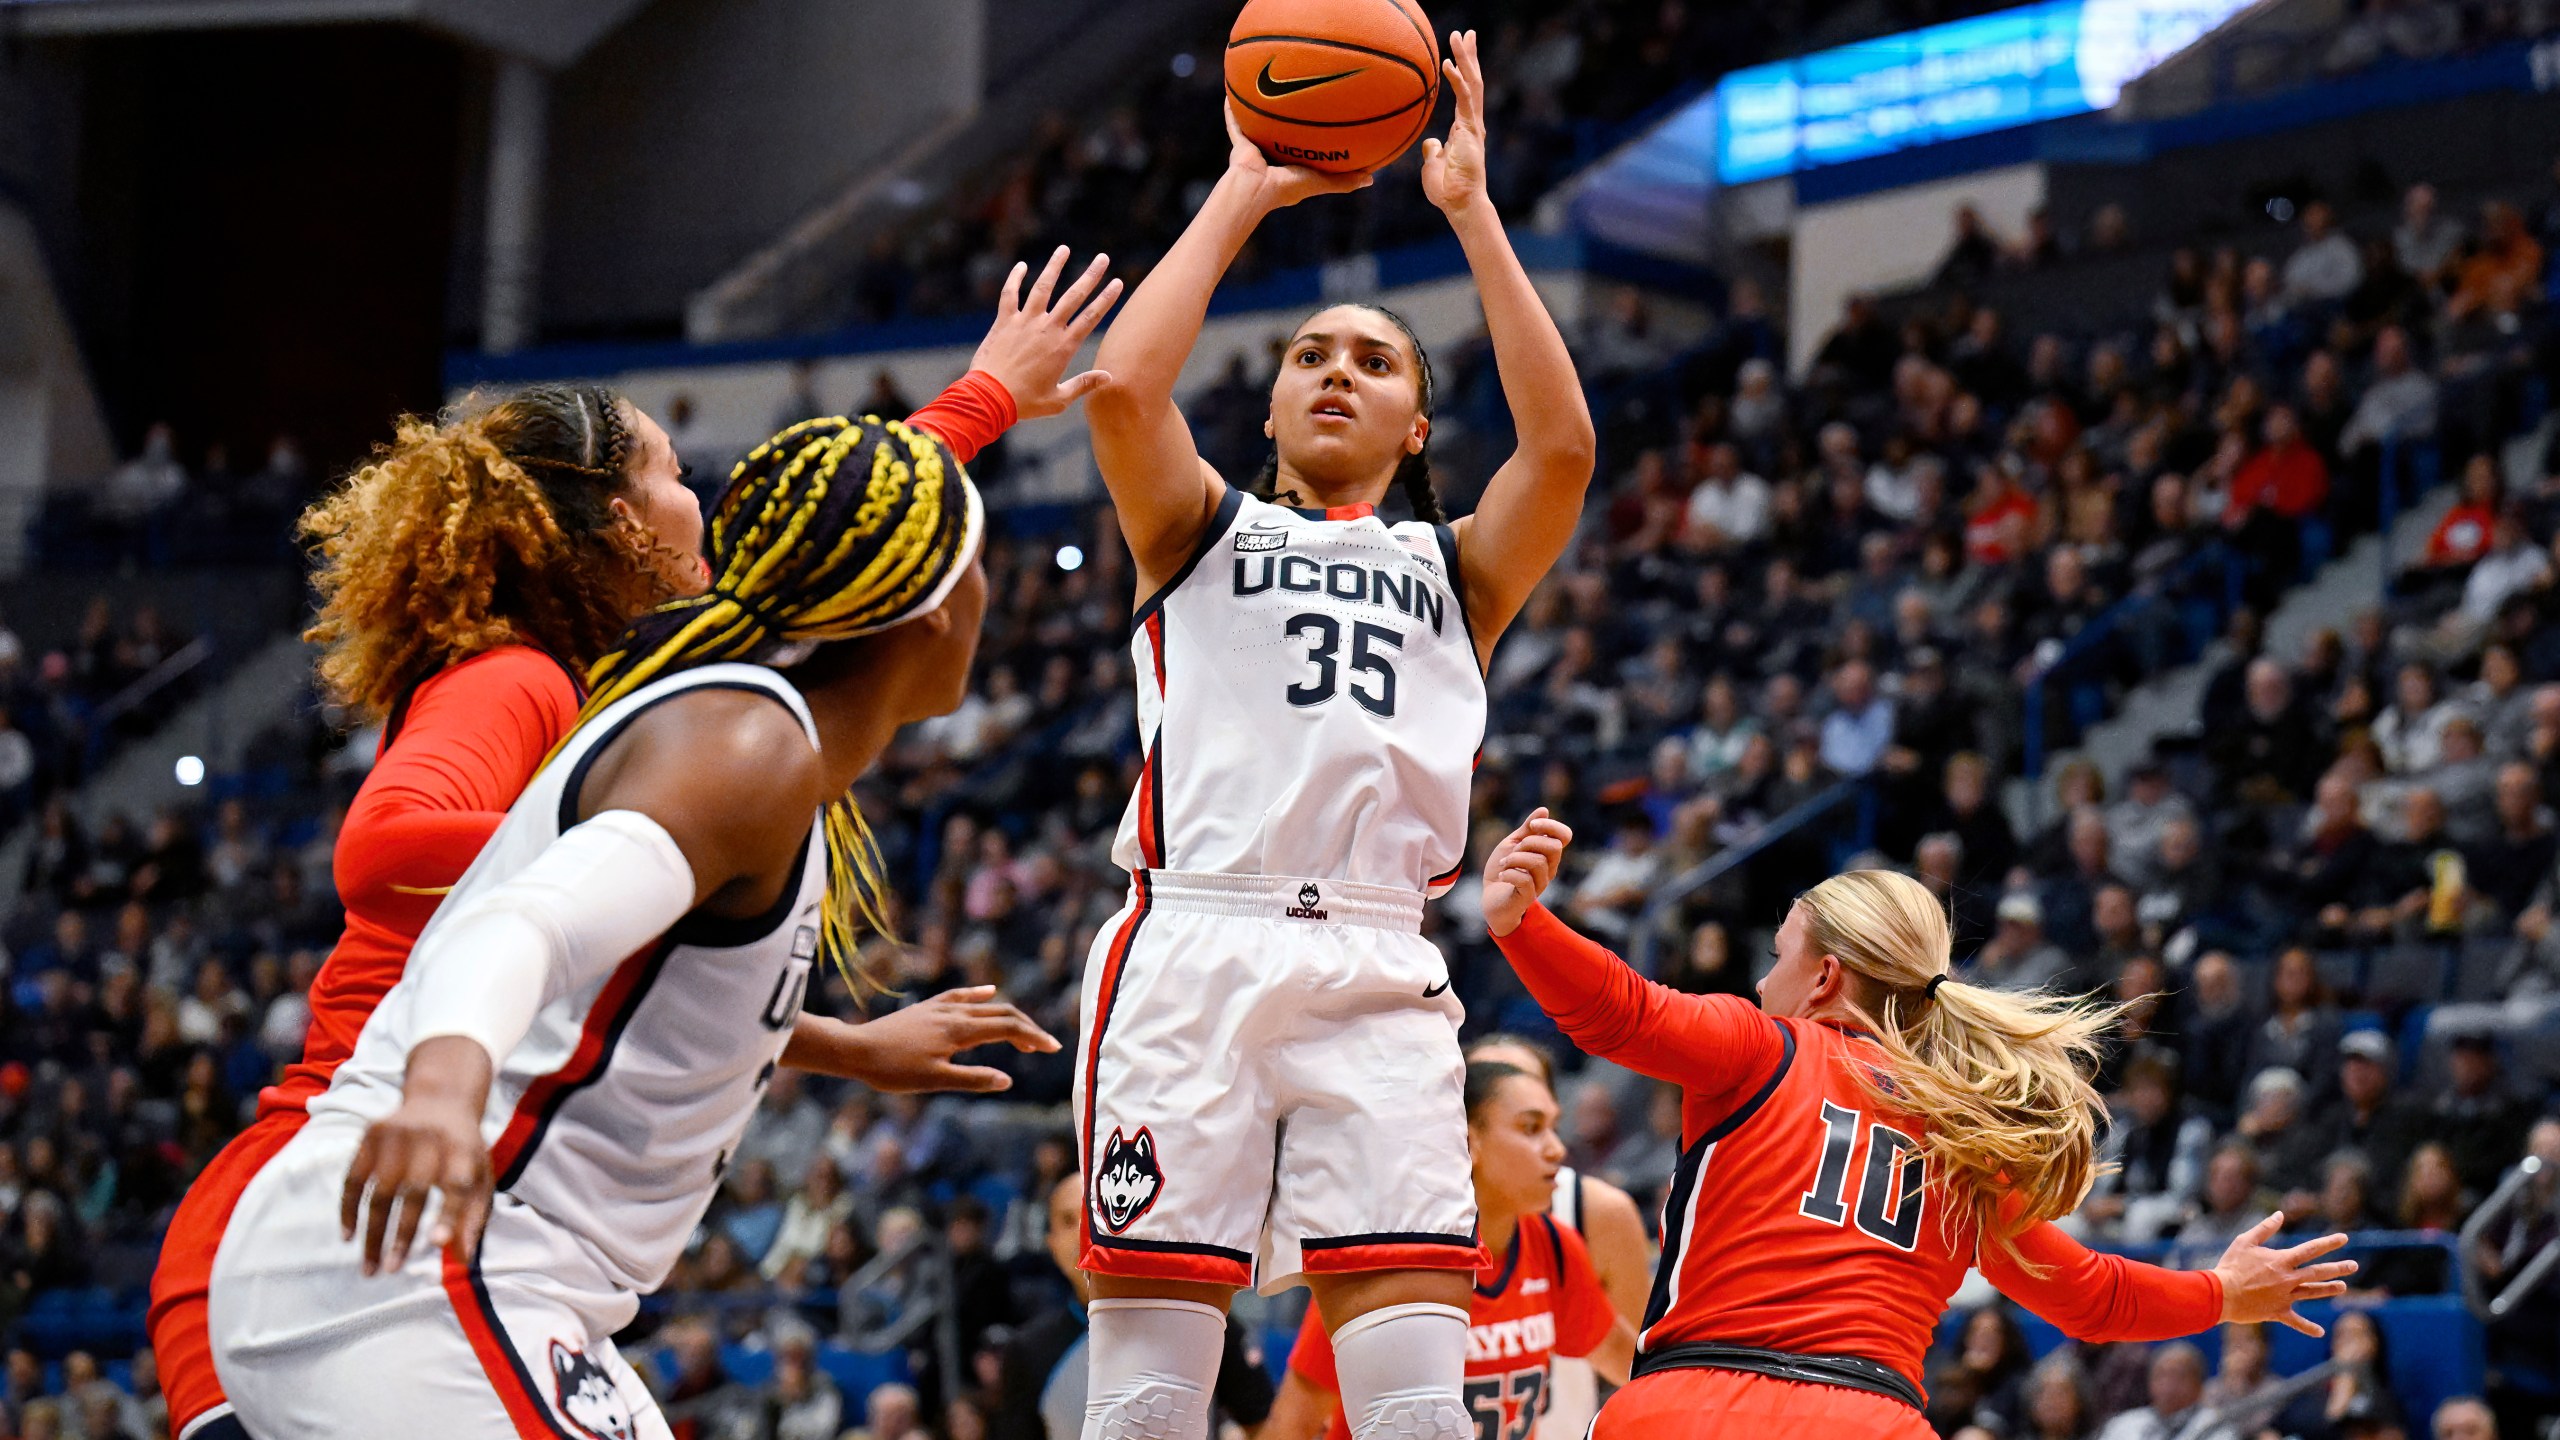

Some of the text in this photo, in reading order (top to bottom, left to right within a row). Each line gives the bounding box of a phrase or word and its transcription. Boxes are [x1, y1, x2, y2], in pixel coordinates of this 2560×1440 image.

[1273, 142, 1350, 162] UCONN
[1233, 555, 1444, 637] UCONN
[1284, 612, 1405, 719] 35
[1286, 907, 1328, 920] UCONN
[1798, 1097, 1927, 1253] 10
